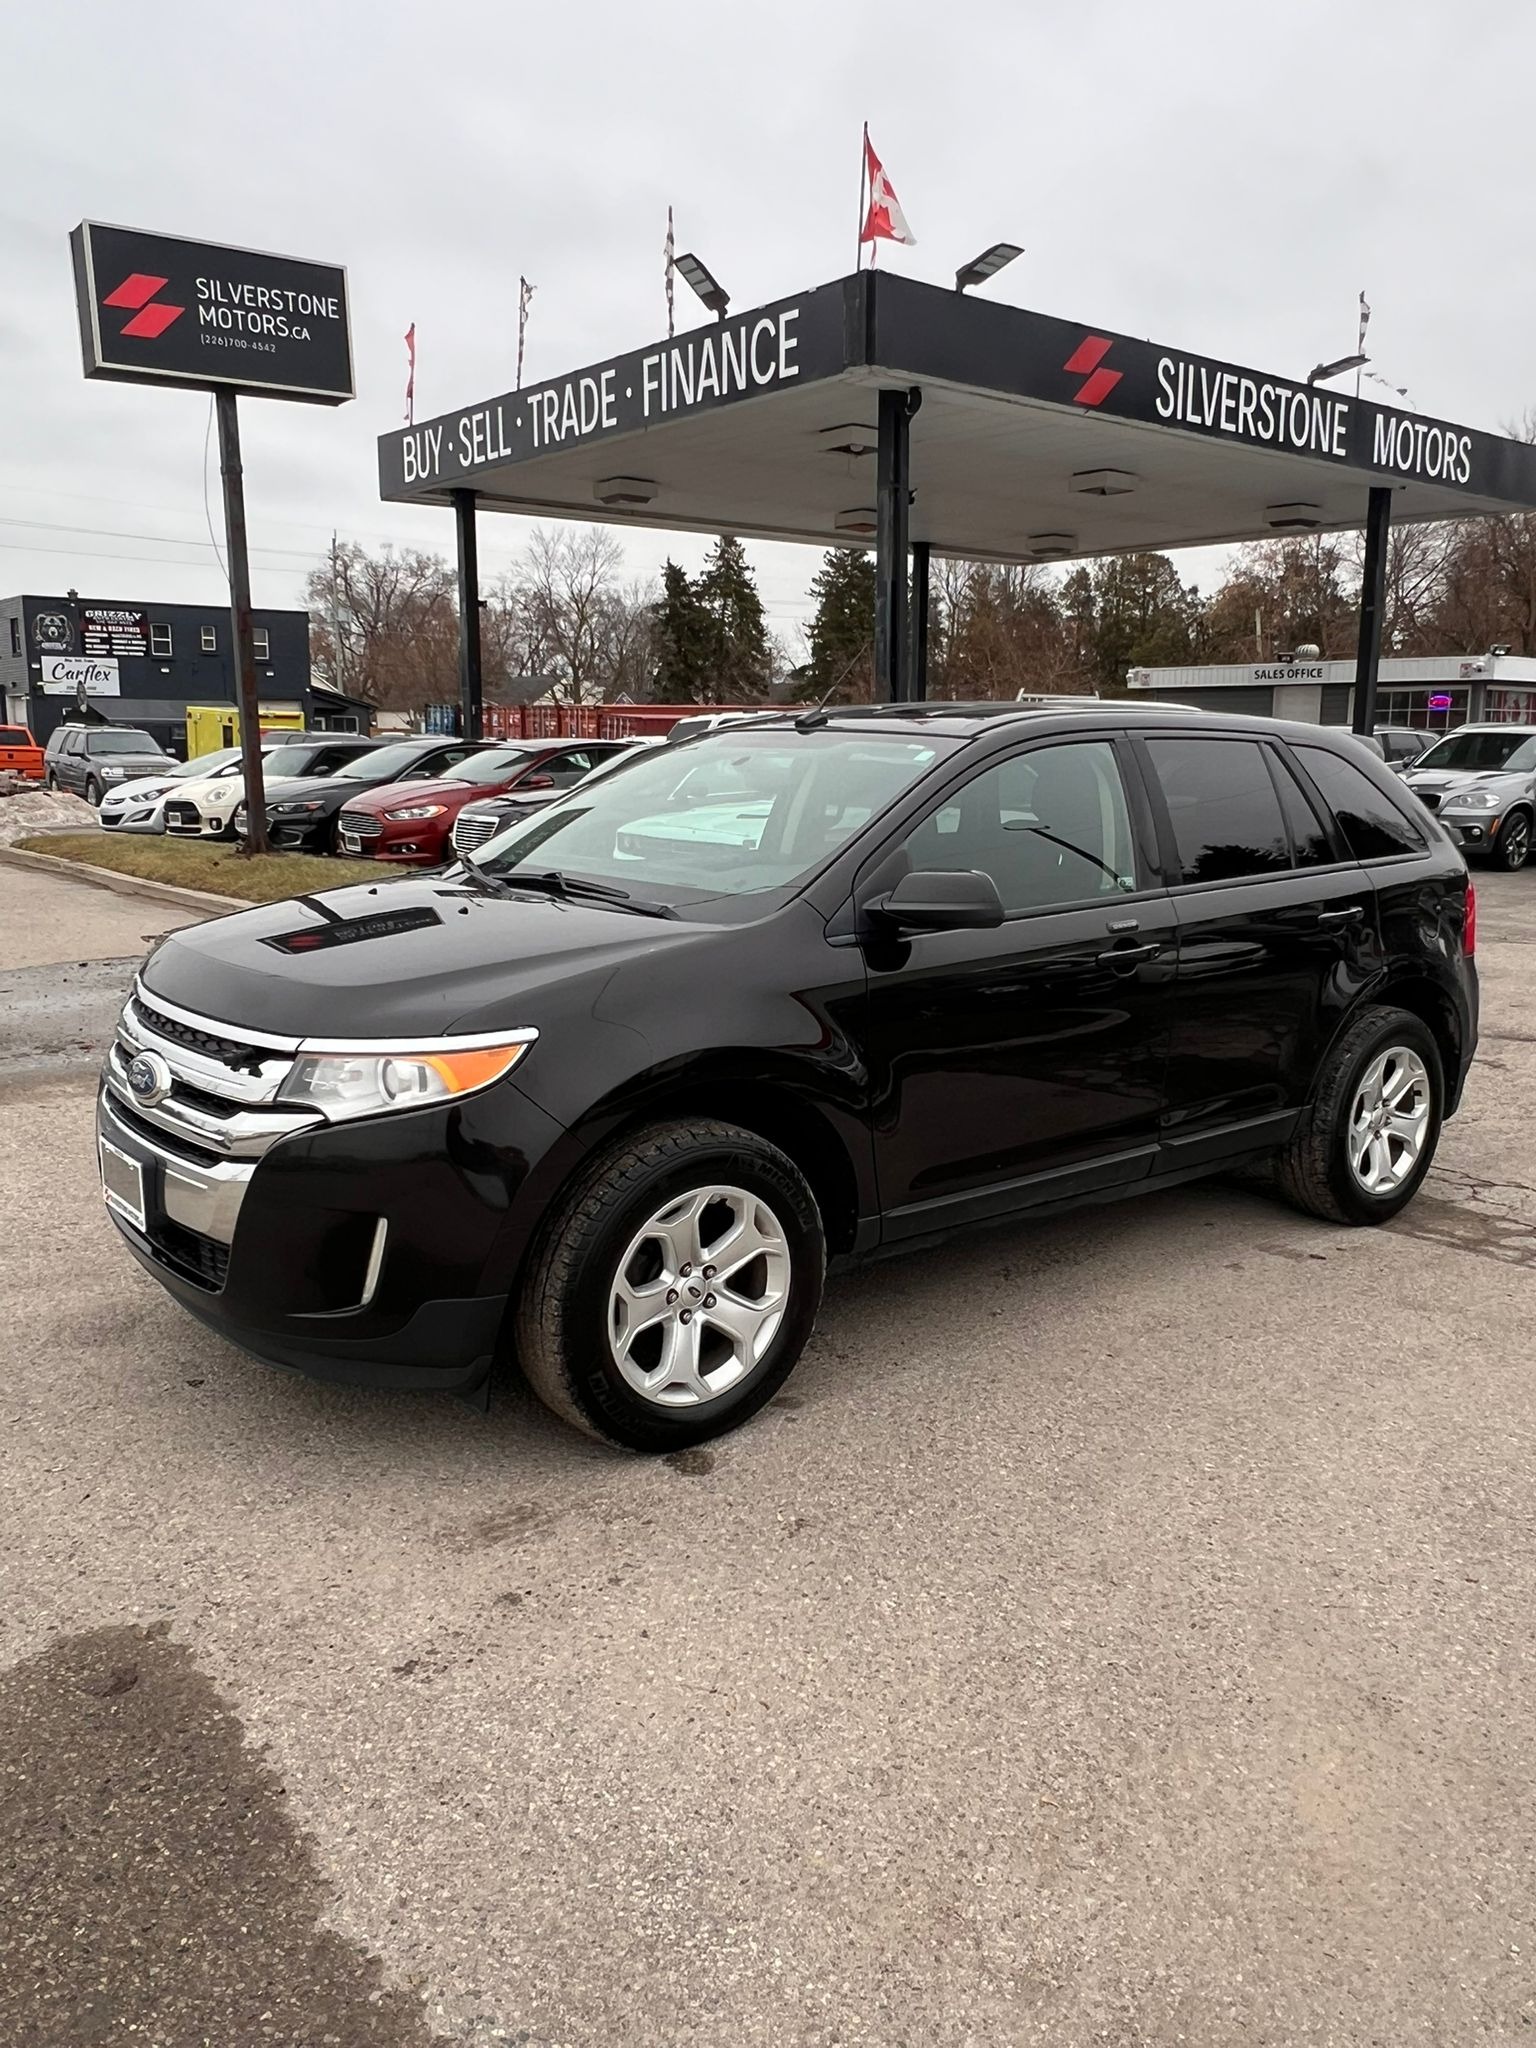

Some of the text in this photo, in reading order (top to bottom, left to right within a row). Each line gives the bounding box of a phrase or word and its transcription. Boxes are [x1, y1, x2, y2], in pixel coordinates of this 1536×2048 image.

[195, 277, 340, 319] SILVERSTONE
[198, 304, 311, 341] MOTORS.CA
[403, 308, 800, 483] BUY SELL TRADE FINANCE
[1155, 357, 1472, 484] SILVERSTONE MOTORS
[85, 610, 142, 620] GRIZZLY
[52, 662, 111, 684] Carflex
[1254, 668, 1323, 679] SALES OFFICE
